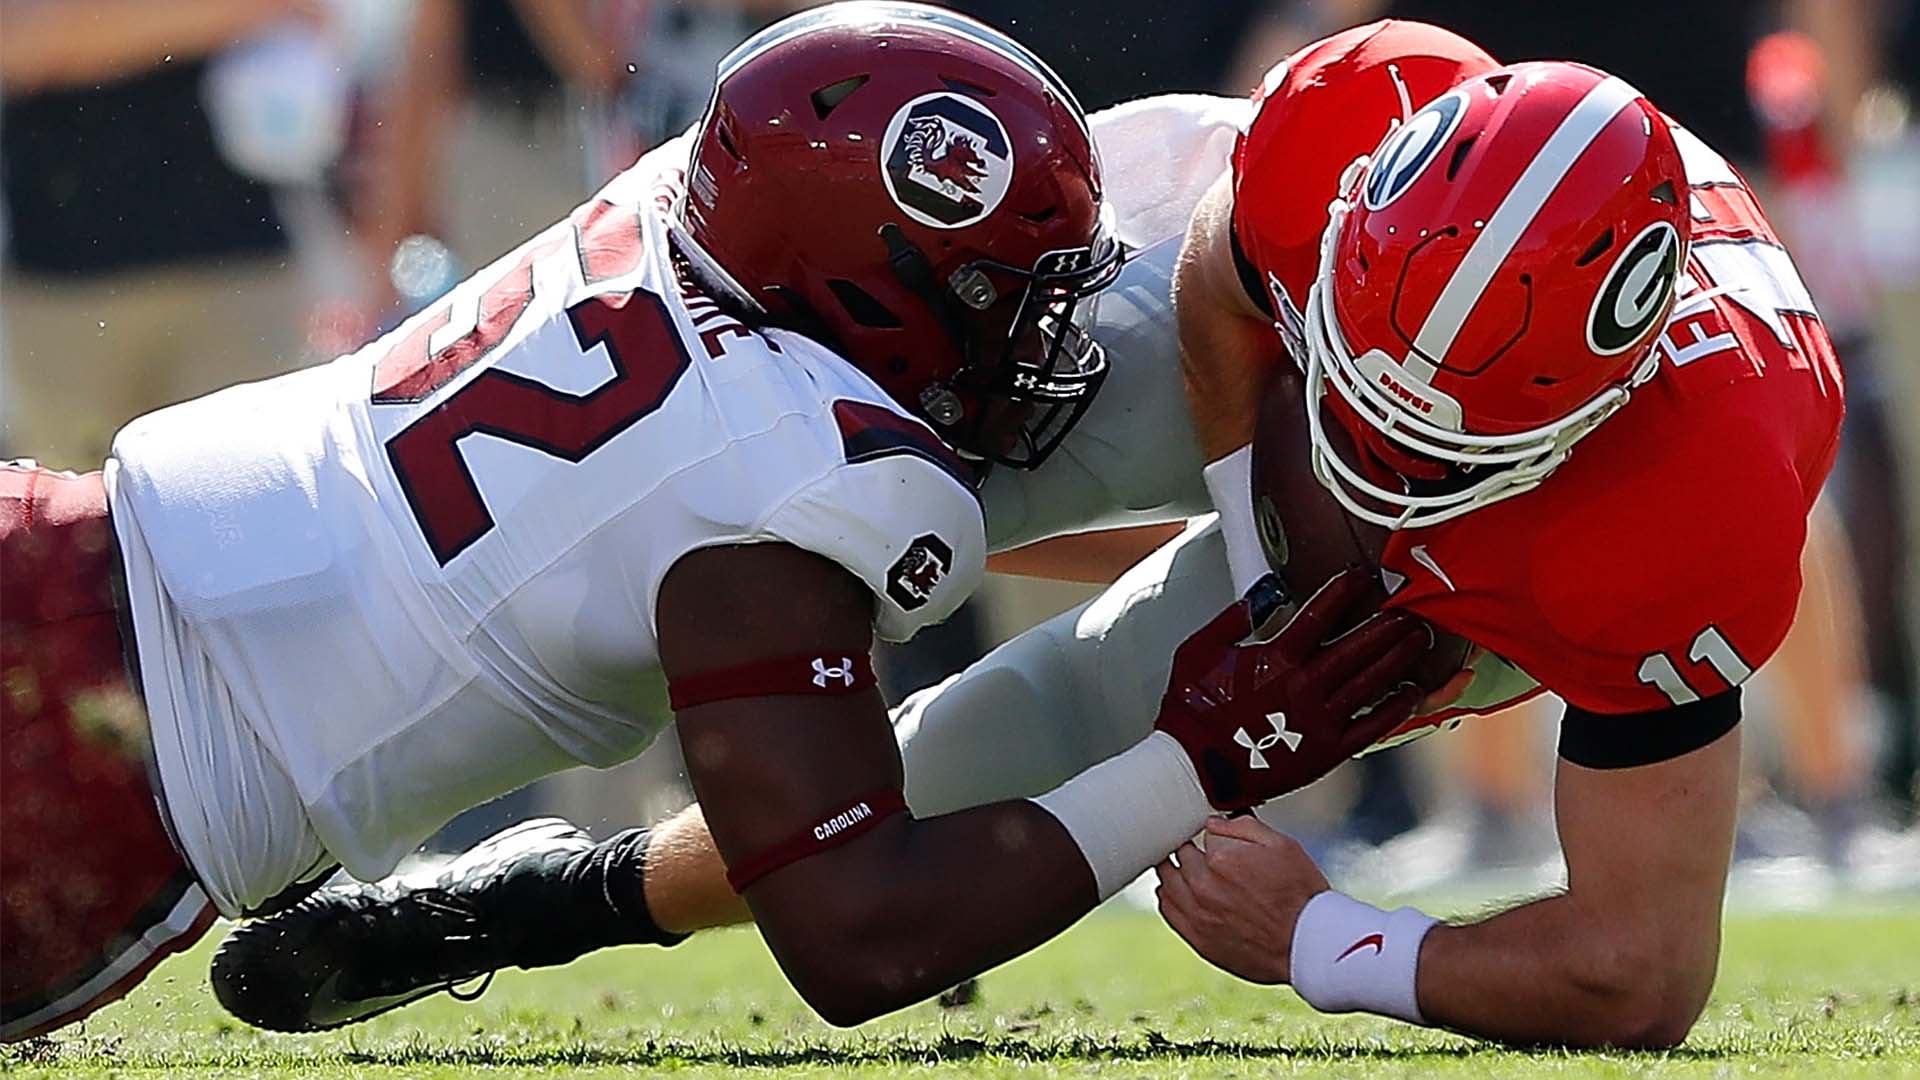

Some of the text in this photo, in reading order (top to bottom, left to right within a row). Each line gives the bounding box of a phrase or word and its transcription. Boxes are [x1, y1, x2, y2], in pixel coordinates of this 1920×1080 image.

[1589, 222, 1679, 353] G
[1378, 371, 1435, 415] DAWGS
[1637, 624, 1752, 706] 11
[813, 802, 873, 841] CAROLINA
